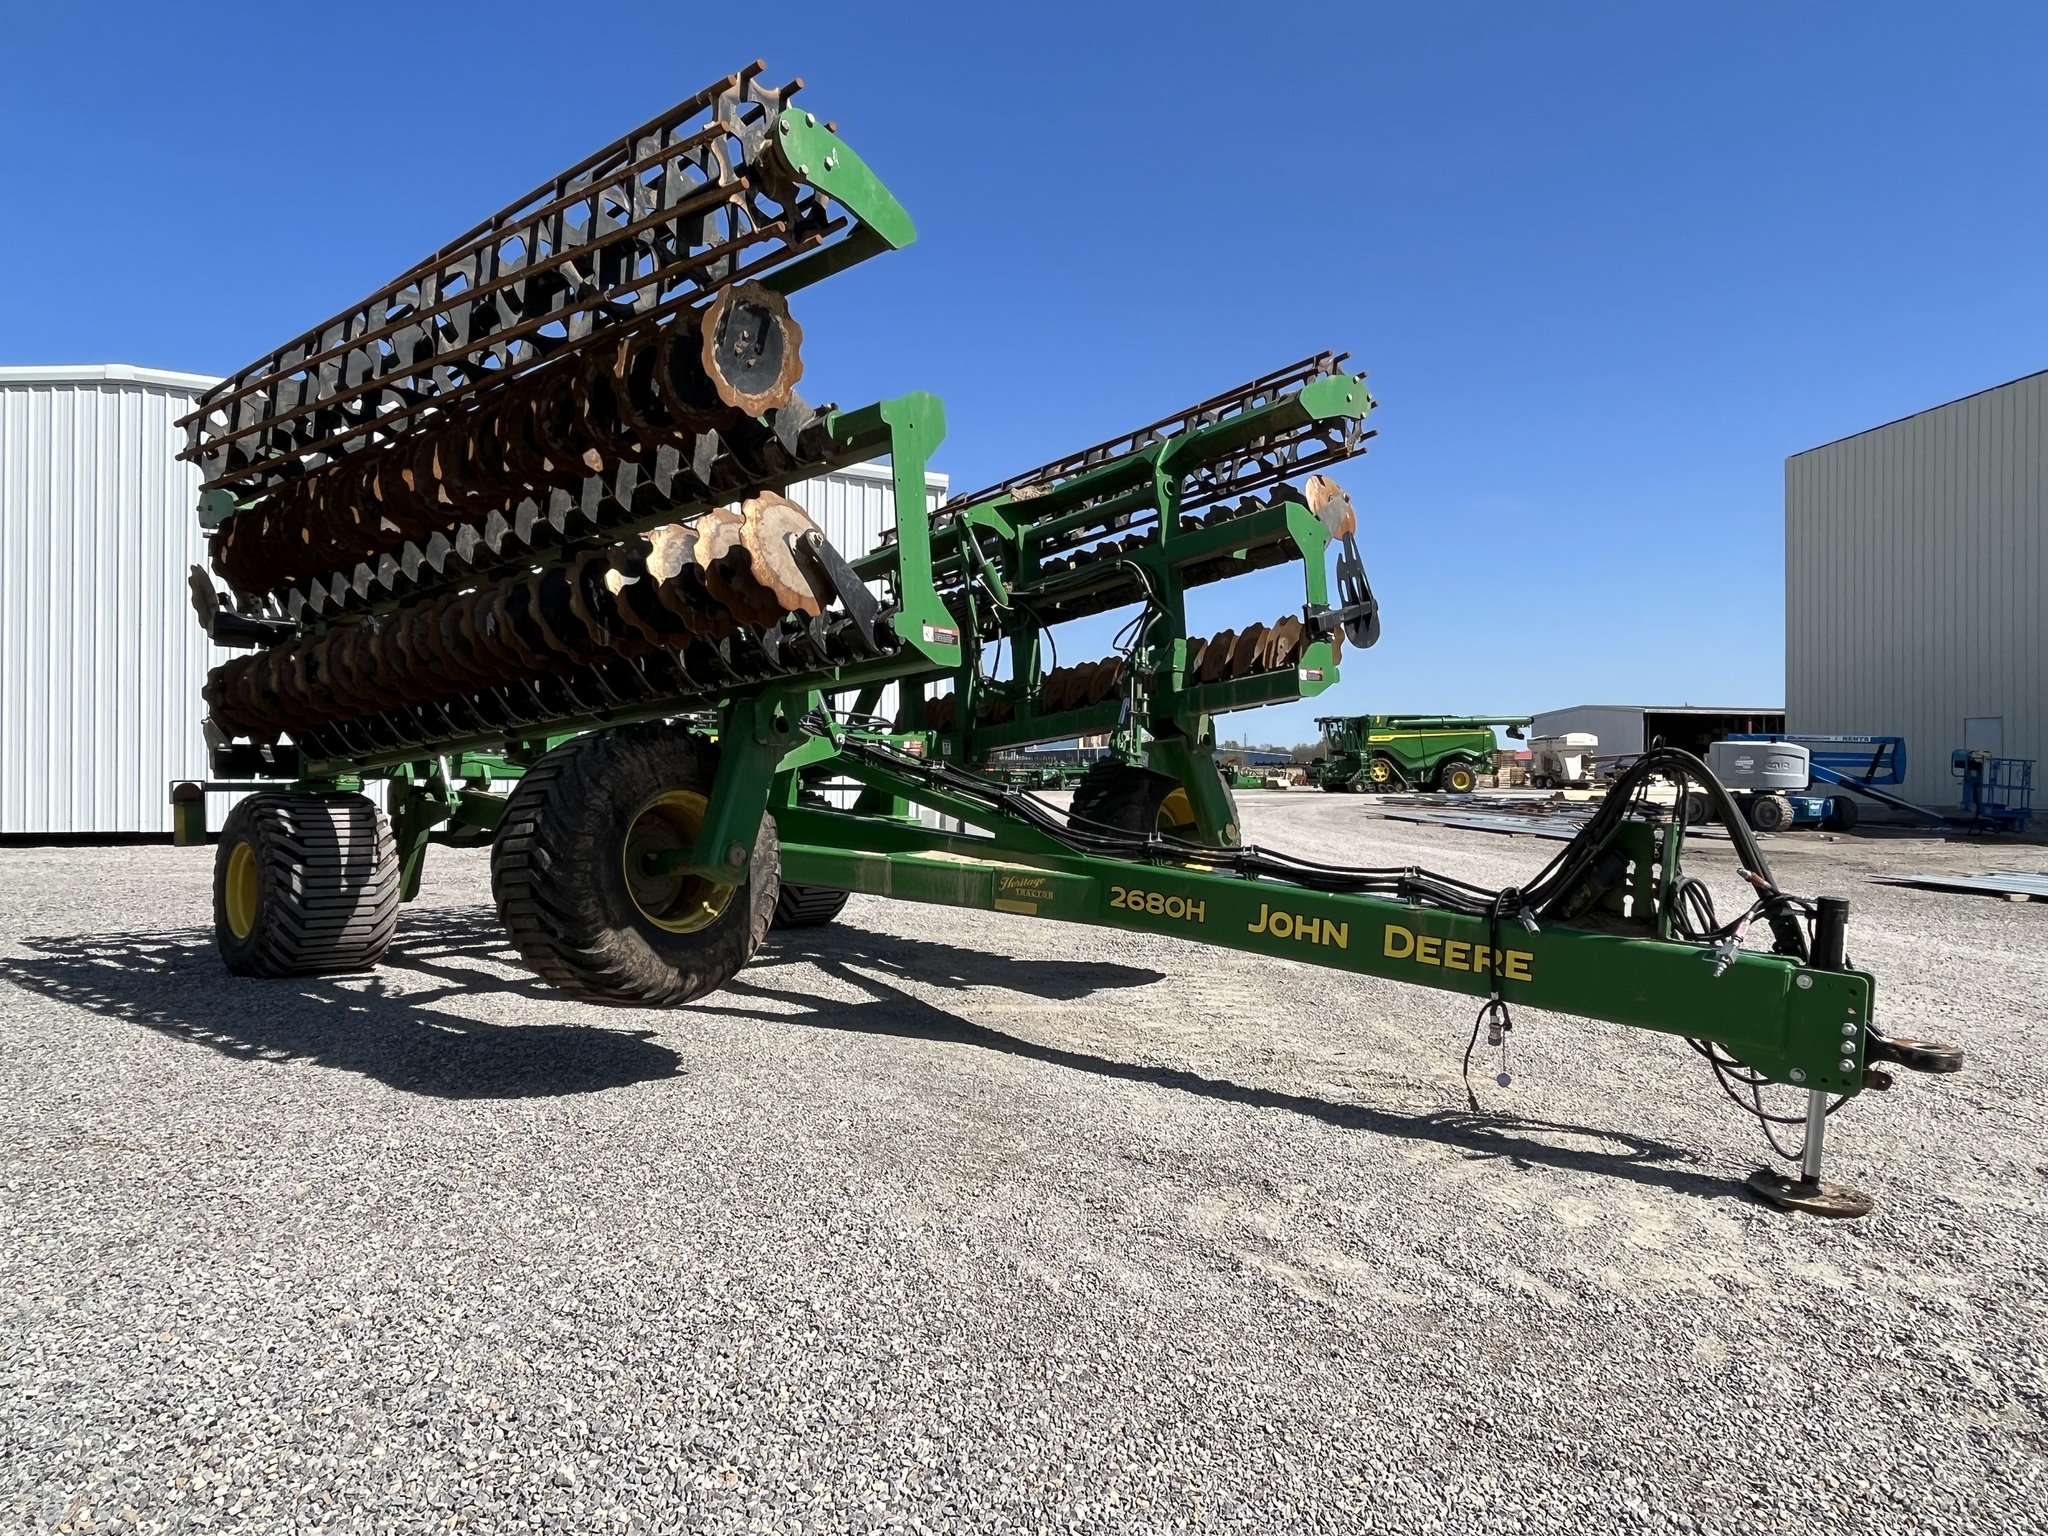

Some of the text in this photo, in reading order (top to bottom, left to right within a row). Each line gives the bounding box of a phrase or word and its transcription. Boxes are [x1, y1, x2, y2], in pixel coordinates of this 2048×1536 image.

[998, 876, 1046, 891] Heritage
[1110, 886, 1205, 923] 2680H
[1248, 903, 1534, 982] JOHN DEERE
